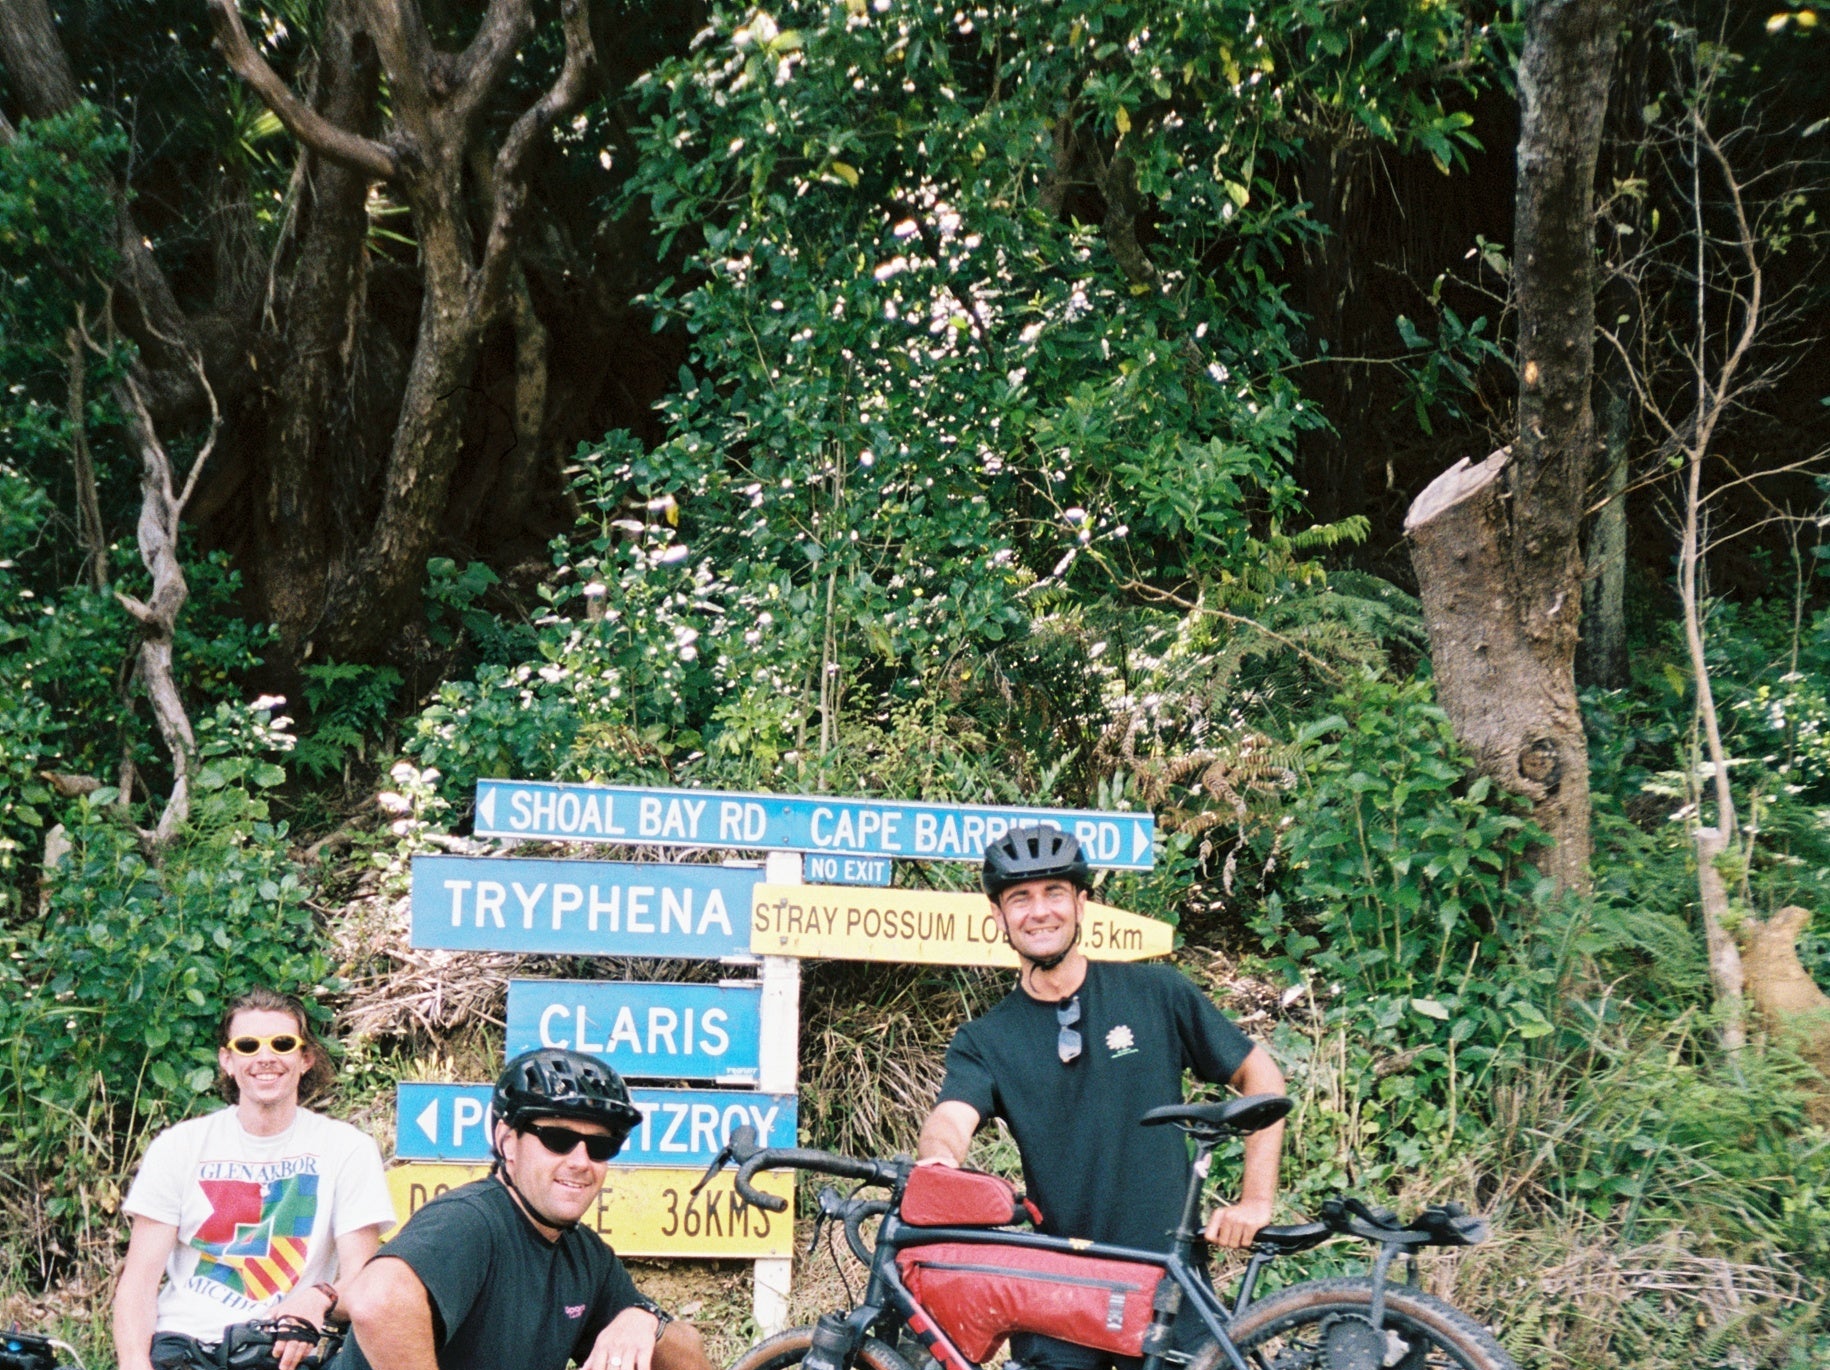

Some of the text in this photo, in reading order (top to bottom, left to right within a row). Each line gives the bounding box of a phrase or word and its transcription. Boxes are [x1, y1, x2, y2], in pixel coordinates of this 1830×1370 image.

[509, 790, 767, 842] SHOAL BAY RD
[810, 808, 1120, 861] CAPE BARR RD
[811, 858, 885, 883] NO EXIT
[443, 880, 733, 936] TRYPHENA
[755, 902, 839, 937] STRAY
[846, 907, 954, 942] POSSUM
[538, 1004, 730, 1056] CLARIS
